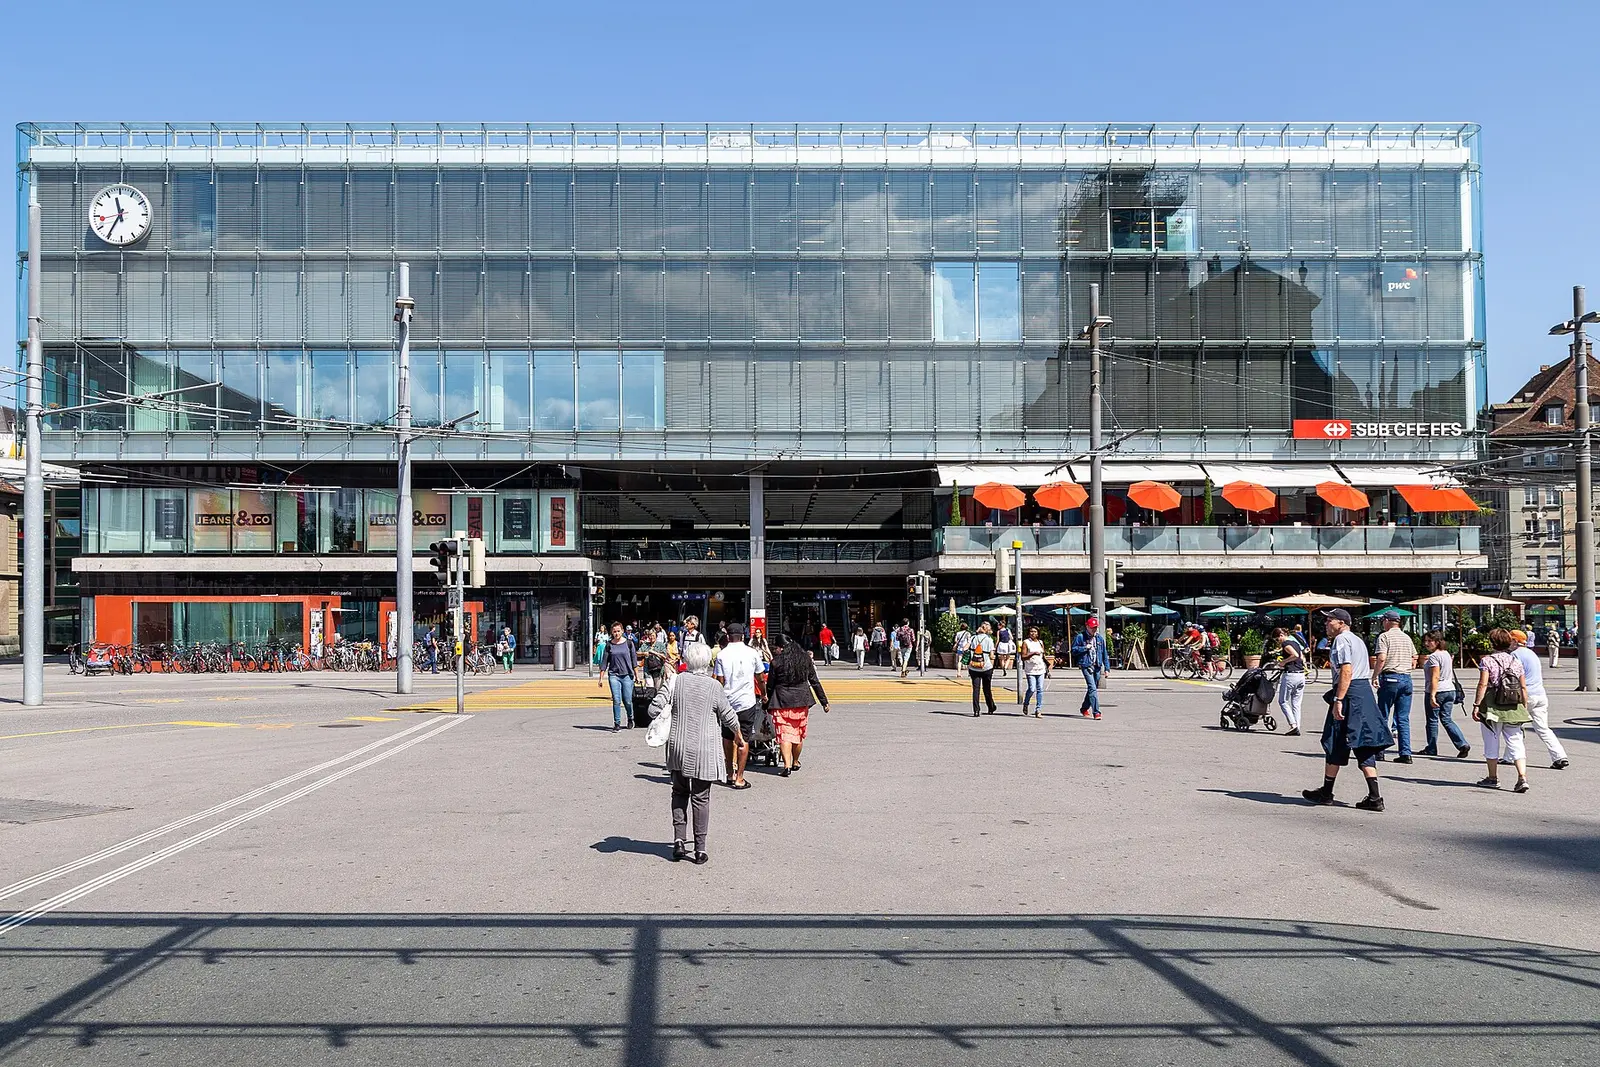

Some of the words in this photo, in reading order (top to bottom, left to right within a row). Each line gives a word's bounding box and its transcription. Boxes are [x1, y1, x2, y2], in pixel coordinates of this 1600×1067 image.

[1388, 282, 1411, 292] pwc
[1356, 422, 1390, 437] SBB
[197, 516, 231, 525] JEANS
[254, 516, 270, 525] CO
[372, 516, 398, 525] JEAN
[430, 516, 444, 525] CO
[468, 502, 482, 538] SALE
[552, 500, 565, 540] SALE
